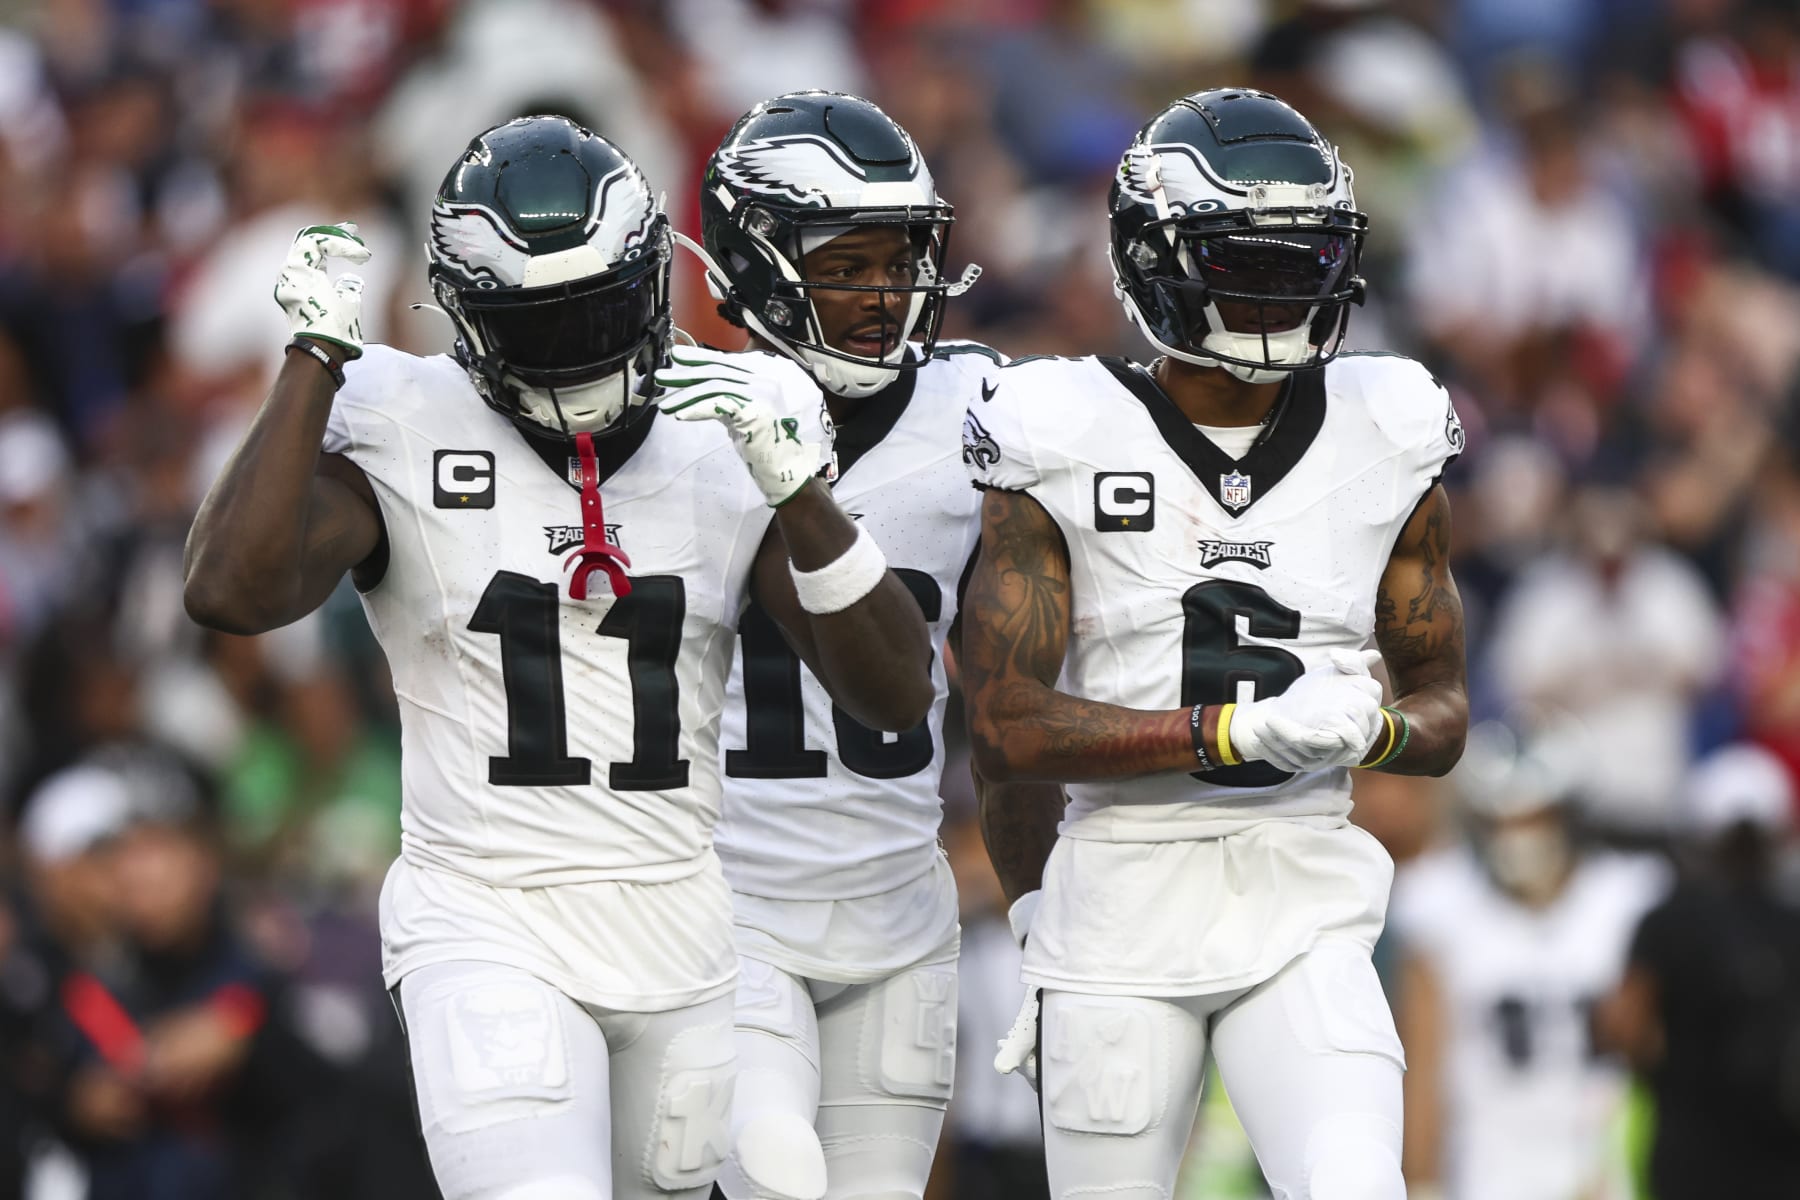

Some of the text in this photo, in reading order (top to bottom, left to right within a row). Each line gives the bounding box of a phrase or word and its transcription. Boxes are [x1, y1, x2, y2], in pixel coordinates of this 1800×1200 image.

[438, 454, 490, 493] C
[1099, 476, 1150, 516] C
[1226, 488, 1247, 502] NFL
[542, 524, 623, 555] EAGS
[1197, 540, 1275, 570] EAGLES
[466, 569, 690, 792] 11
[1181, 579, 1305, 788] 6
